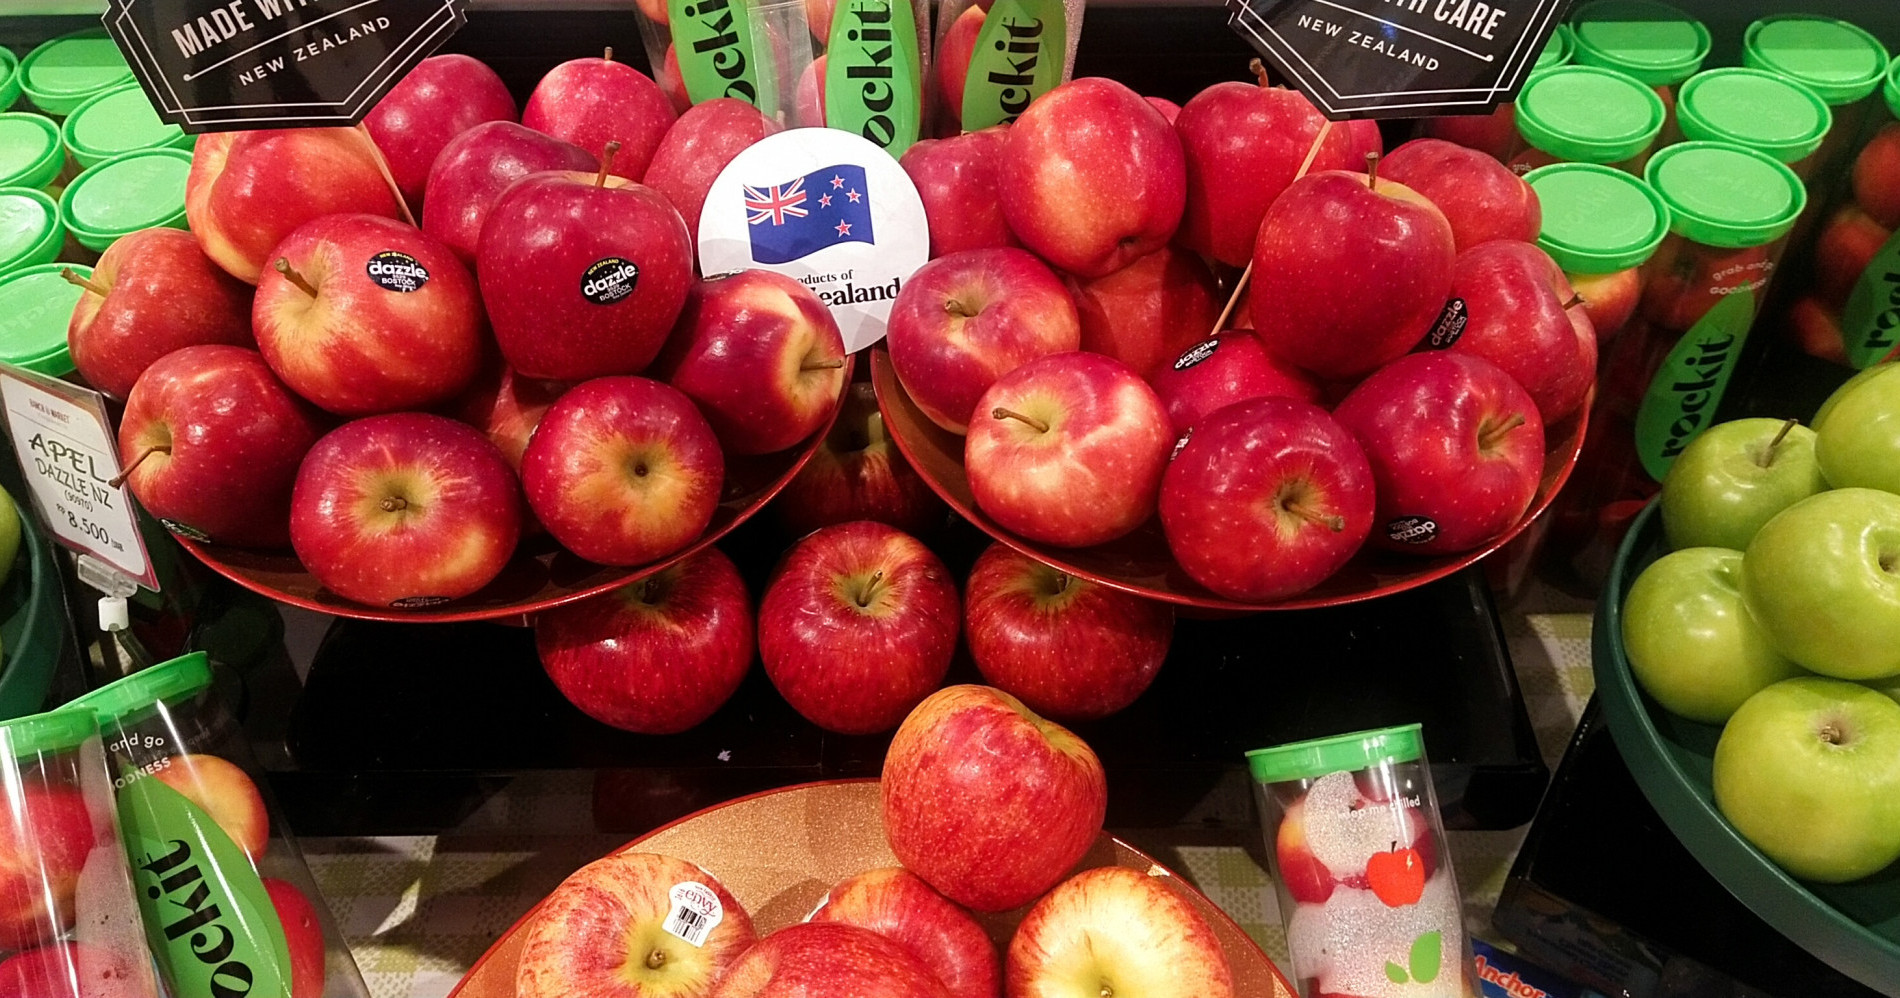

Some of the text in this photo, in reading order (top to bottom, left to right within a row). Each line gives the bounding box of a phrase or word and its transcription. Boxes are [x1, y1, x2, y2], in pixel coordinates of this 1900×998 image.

[171, 0, 254, 58] MADE
[1433, 0, 1507, 40] CARE
[239, 16, 391, 86] NEW ZEALAND
[684, 0, 756, 104] ocki
[1297, 15, 1440, 72] NEW ZEALAND
[846, 0, 895, 148] ockit
[988, 17, 1043, 125] ckit
[368, 260, 427, 279] dazzle
[584, 265, 636, 296] dazzle
[597, 259, 619, 269] ZEALAND
[797, 269, 853, 285] oducts of
[811, 277, 901, 308] ealand
[1432, 300, 1464, 346] dazzle
[1174, 340, 1218, 369] dazzle
[1660, 333, 1735, 458] rockit
[28, 433, 107, 484] APEL
[35, 457, 114, 510] DAZZLE NZ
[68, 510, 109, 545] 8.500
[110, 733, 165, 752] and go
[114, 756, 172, 790] ODNESS
[140, 839, 254, 998] ockit
[685, 889, 718, 918] envy
[1474, 954, 1547, 998] Anchor
